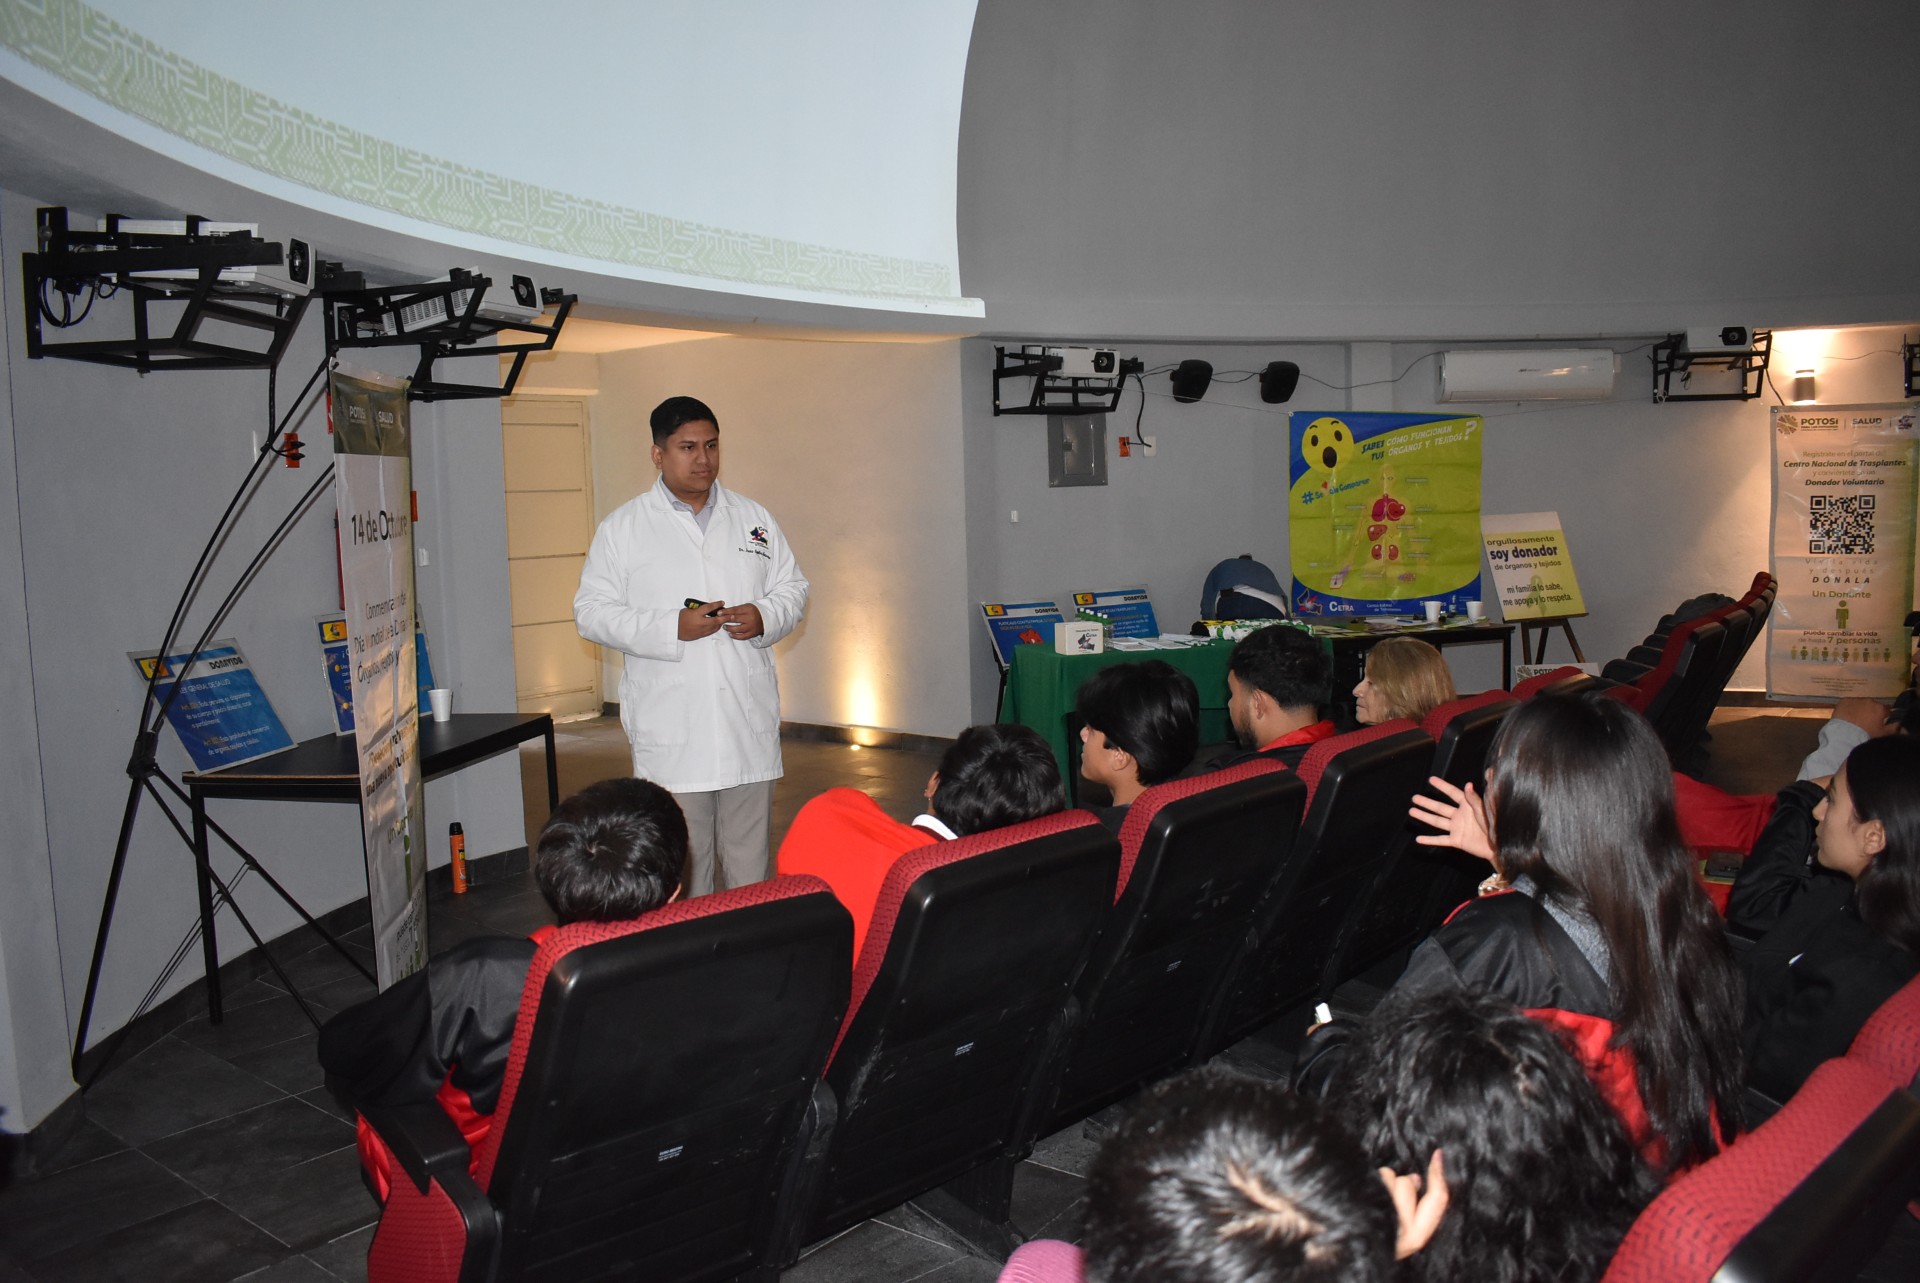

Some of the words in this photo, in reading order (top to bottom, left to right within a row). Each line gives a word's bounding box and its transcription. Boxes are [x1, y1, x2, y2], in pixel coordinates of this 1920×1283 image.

[1425, 440, 1430, 448] Y
[1860, 460, 1906, 468] Trasplantes
[352, 514, 364, 546] 14
[366, 510, 378, 543] de
[1487, 536, 1555, 546] orgullosamente
[1490, 550, 1509, 562] soy
[1512, 545, 1558, 558] donador
[1505, 562, 1532, 571] órganos
[1539, 560, 1562, 568] tejidos
[1507, 585, 1515, 593] mi
[1515, 584, 1537, 593] familia
[1545, 582, 1563, 591] sabe,
[1812, 590, 1826, 598] Un
[1514, 598, 1533, 606] apoya
